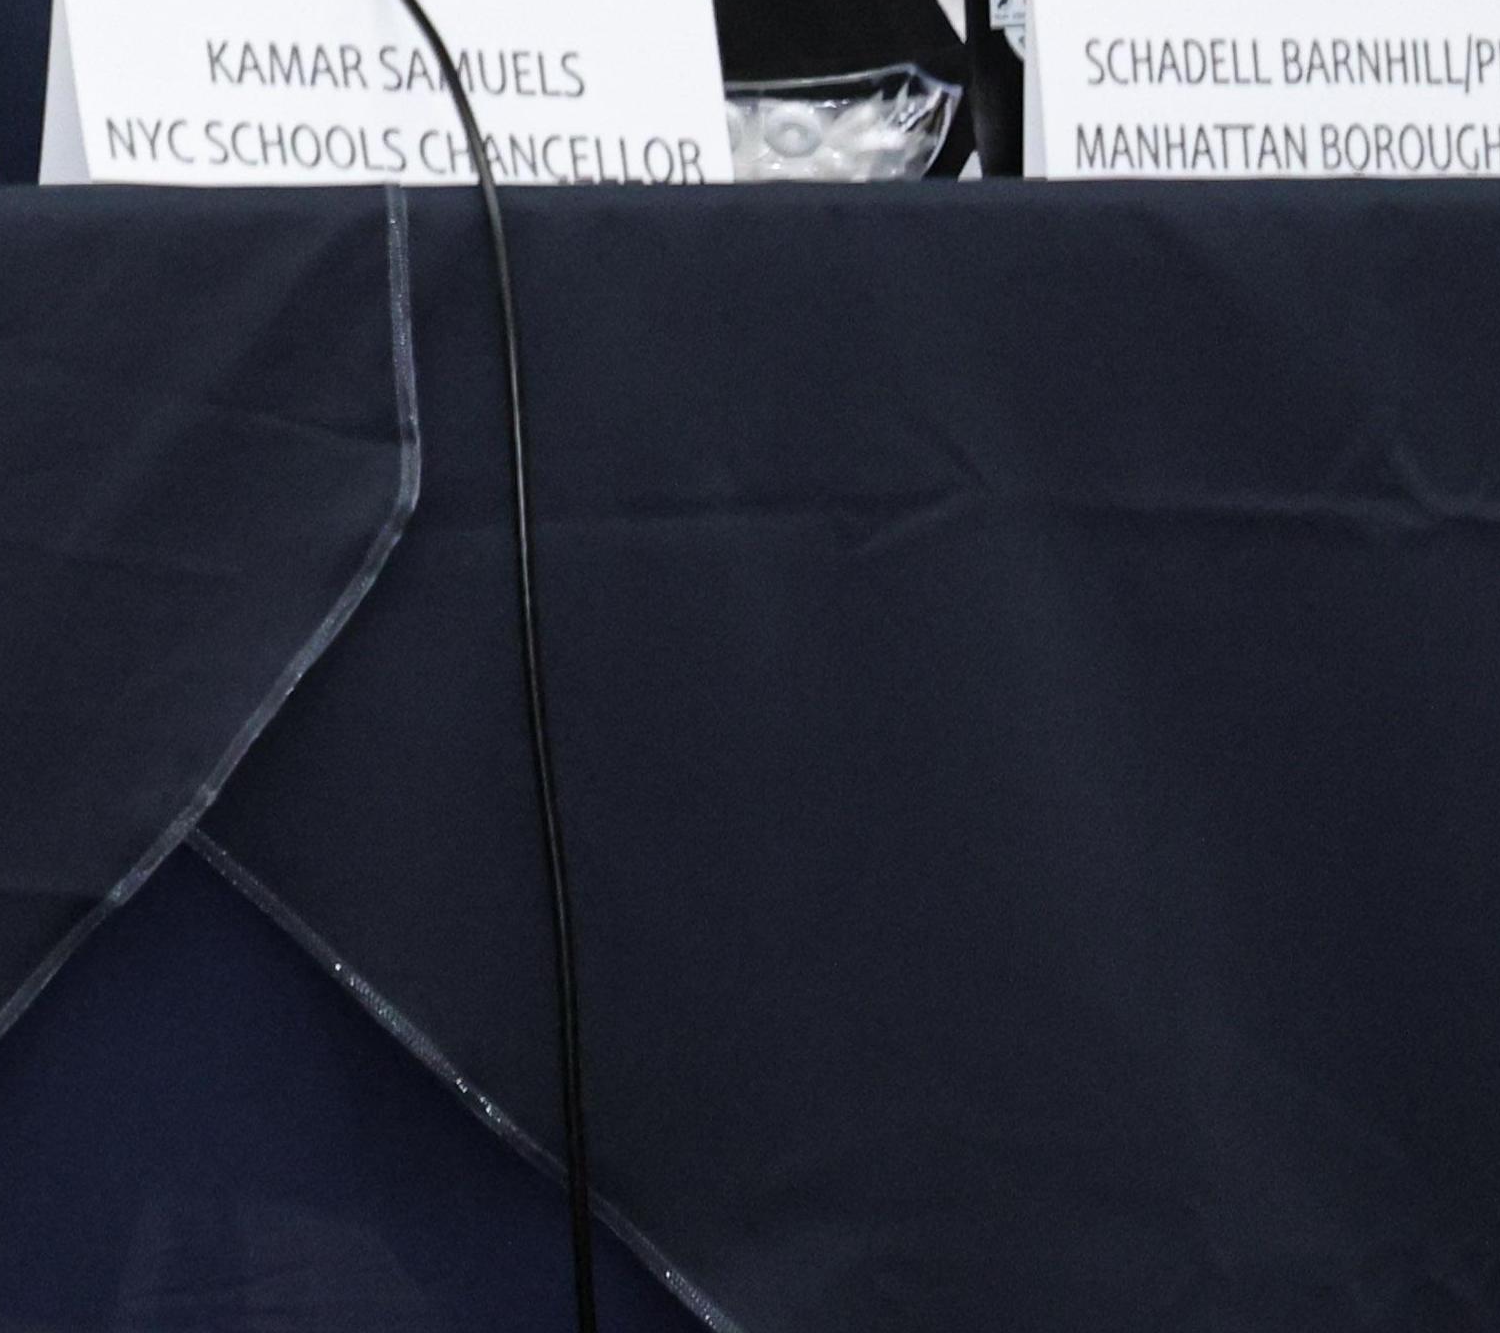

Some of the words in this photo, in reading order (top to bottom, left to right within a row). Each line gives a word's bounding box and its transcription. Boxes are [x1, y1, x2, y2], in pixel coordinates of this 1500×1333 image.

[206, 41, 369, 89] KAMAR
[379, 44, 585, 98] SAMUELS
[1084, 38, 1272, 86] SCHADELL
[104, 118, 195, 164] NYC
[204, 120, 408, 175] SCHOOLS
[418, 129, 707, 185] CHANCELLOR
[1075, 123, 1307, 170] MANHATTAN
